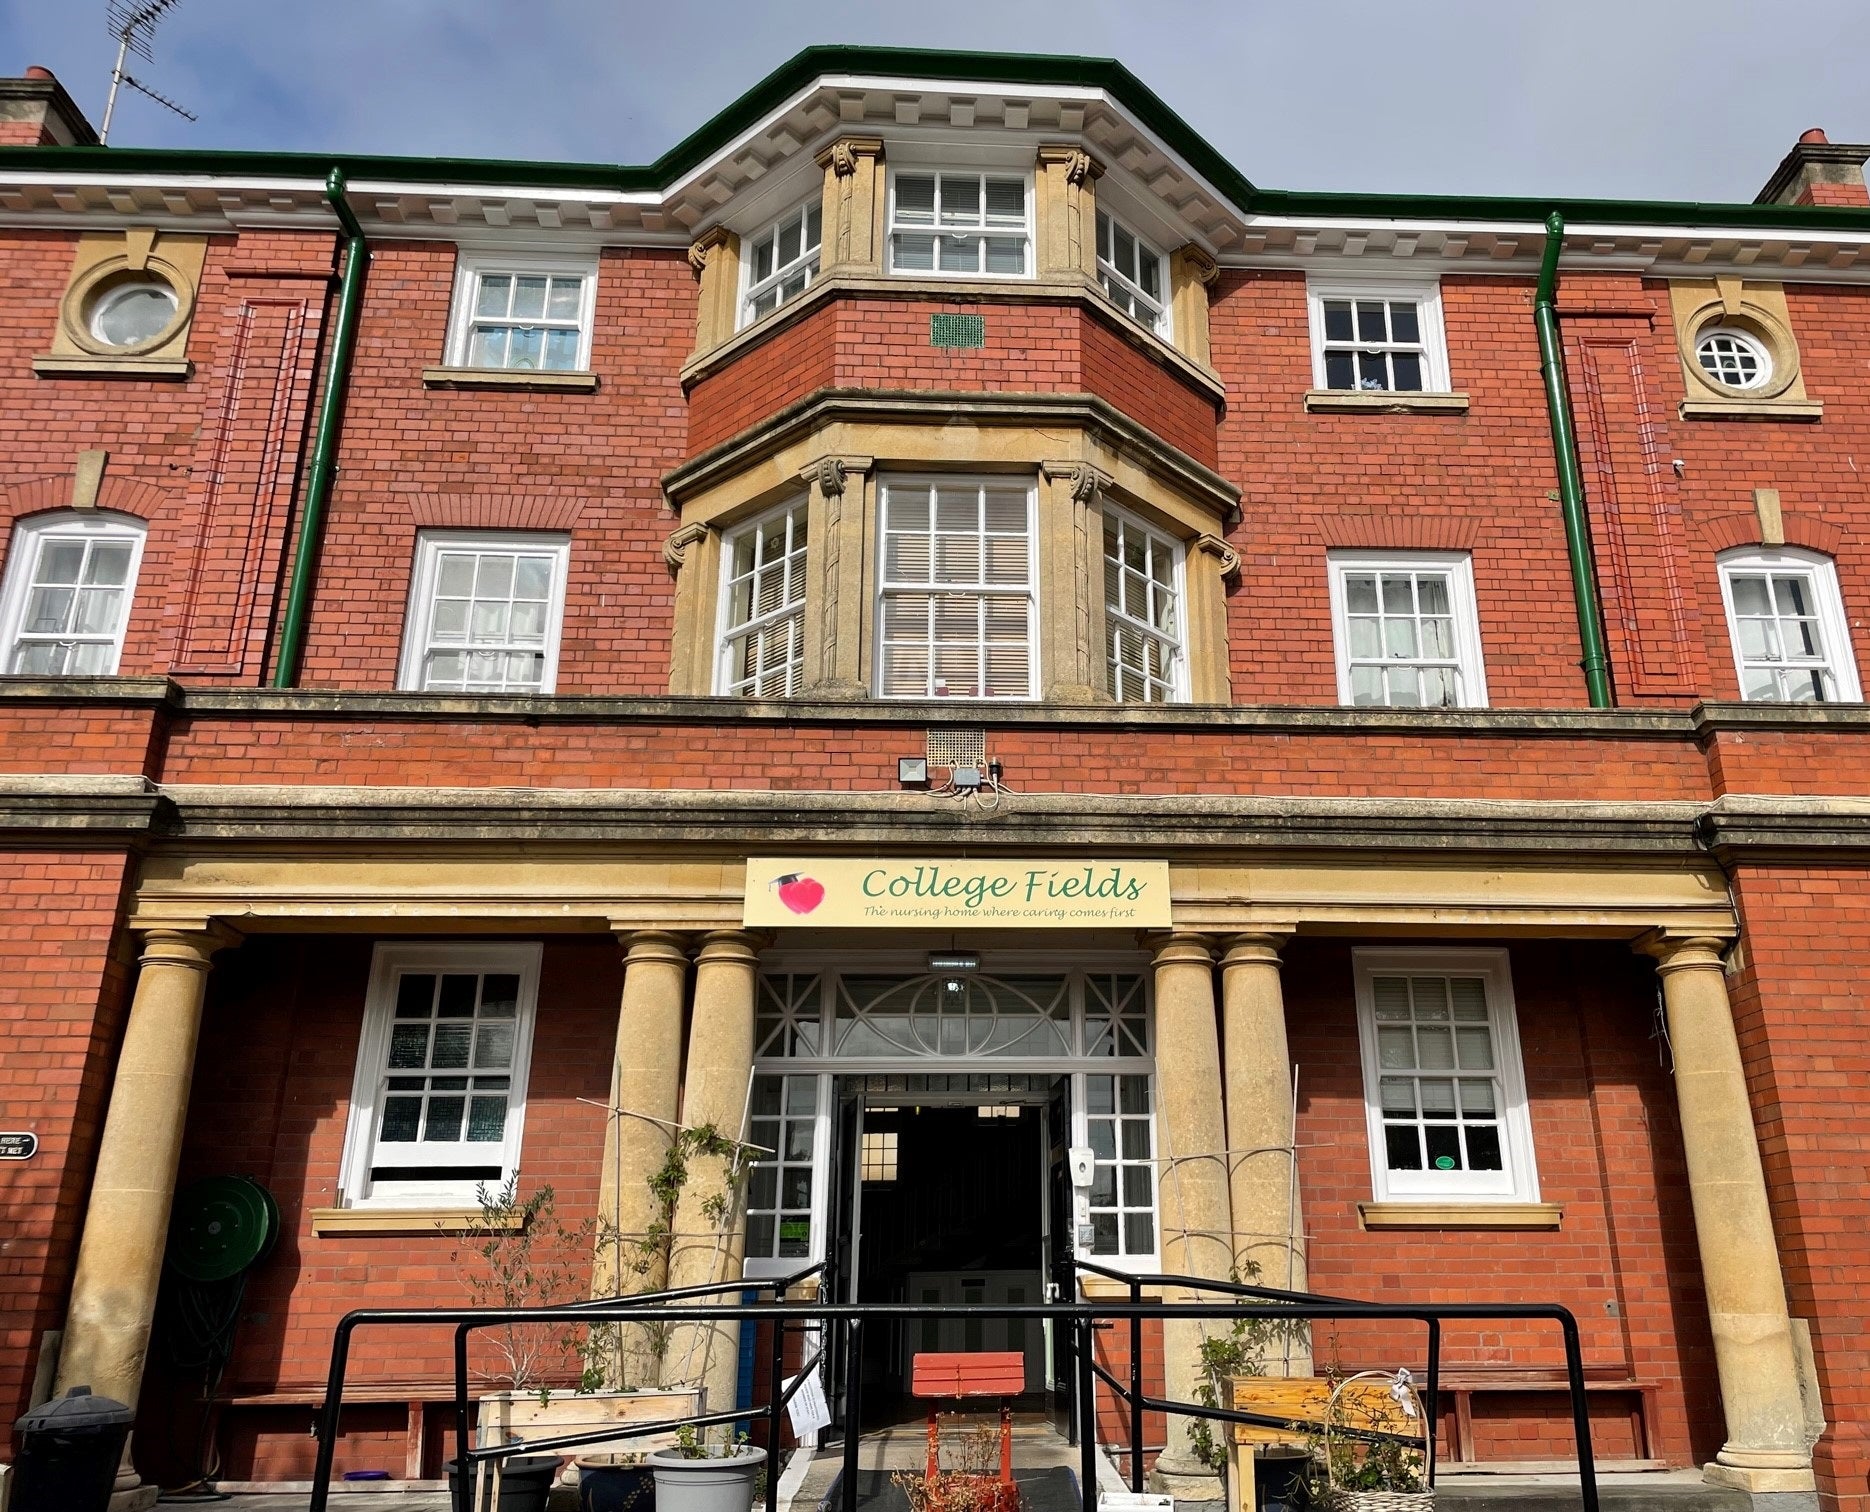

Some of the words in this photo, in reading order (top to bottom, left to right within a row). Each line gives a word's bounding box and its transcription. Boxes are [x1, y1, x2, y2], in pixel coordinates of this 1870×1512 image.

[862, 866, 1018, 908] College
[1025, 867, 1148, 901] Fields
[864, 905, 889, 917] The
[890, 907, 942, 920] nursing
[944, 906, 981, 917] home
[983, 906, 1022, 917] where
[1022, 907, 1068, 920] caring
[1069, 909, 1109, 918] comes
[1109, 907, 1137, 920] first
